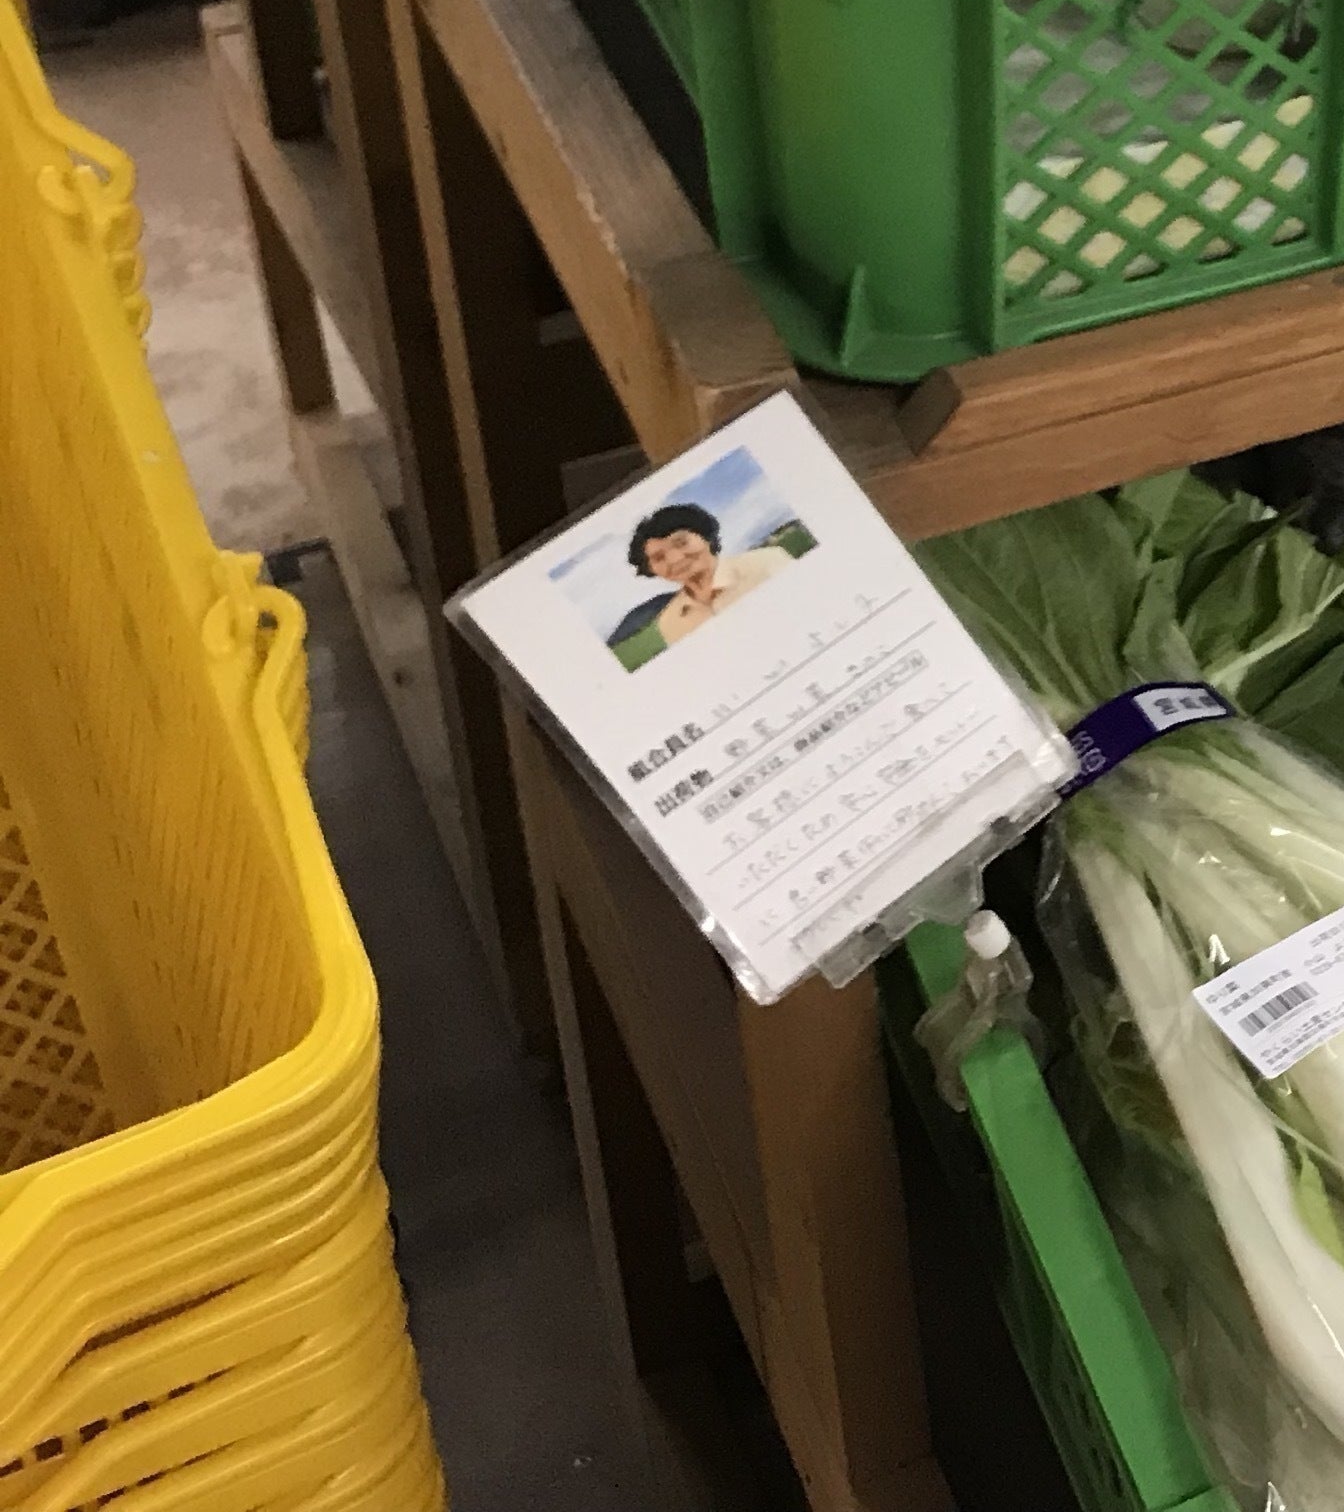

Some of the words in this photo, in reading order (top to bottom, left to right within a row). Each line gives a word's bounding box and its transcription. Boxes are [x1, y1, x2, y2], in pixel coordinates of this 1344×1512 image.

[626, 722, 706, 783] 組合員名
[654, 768, 714, 818] 出荷物
